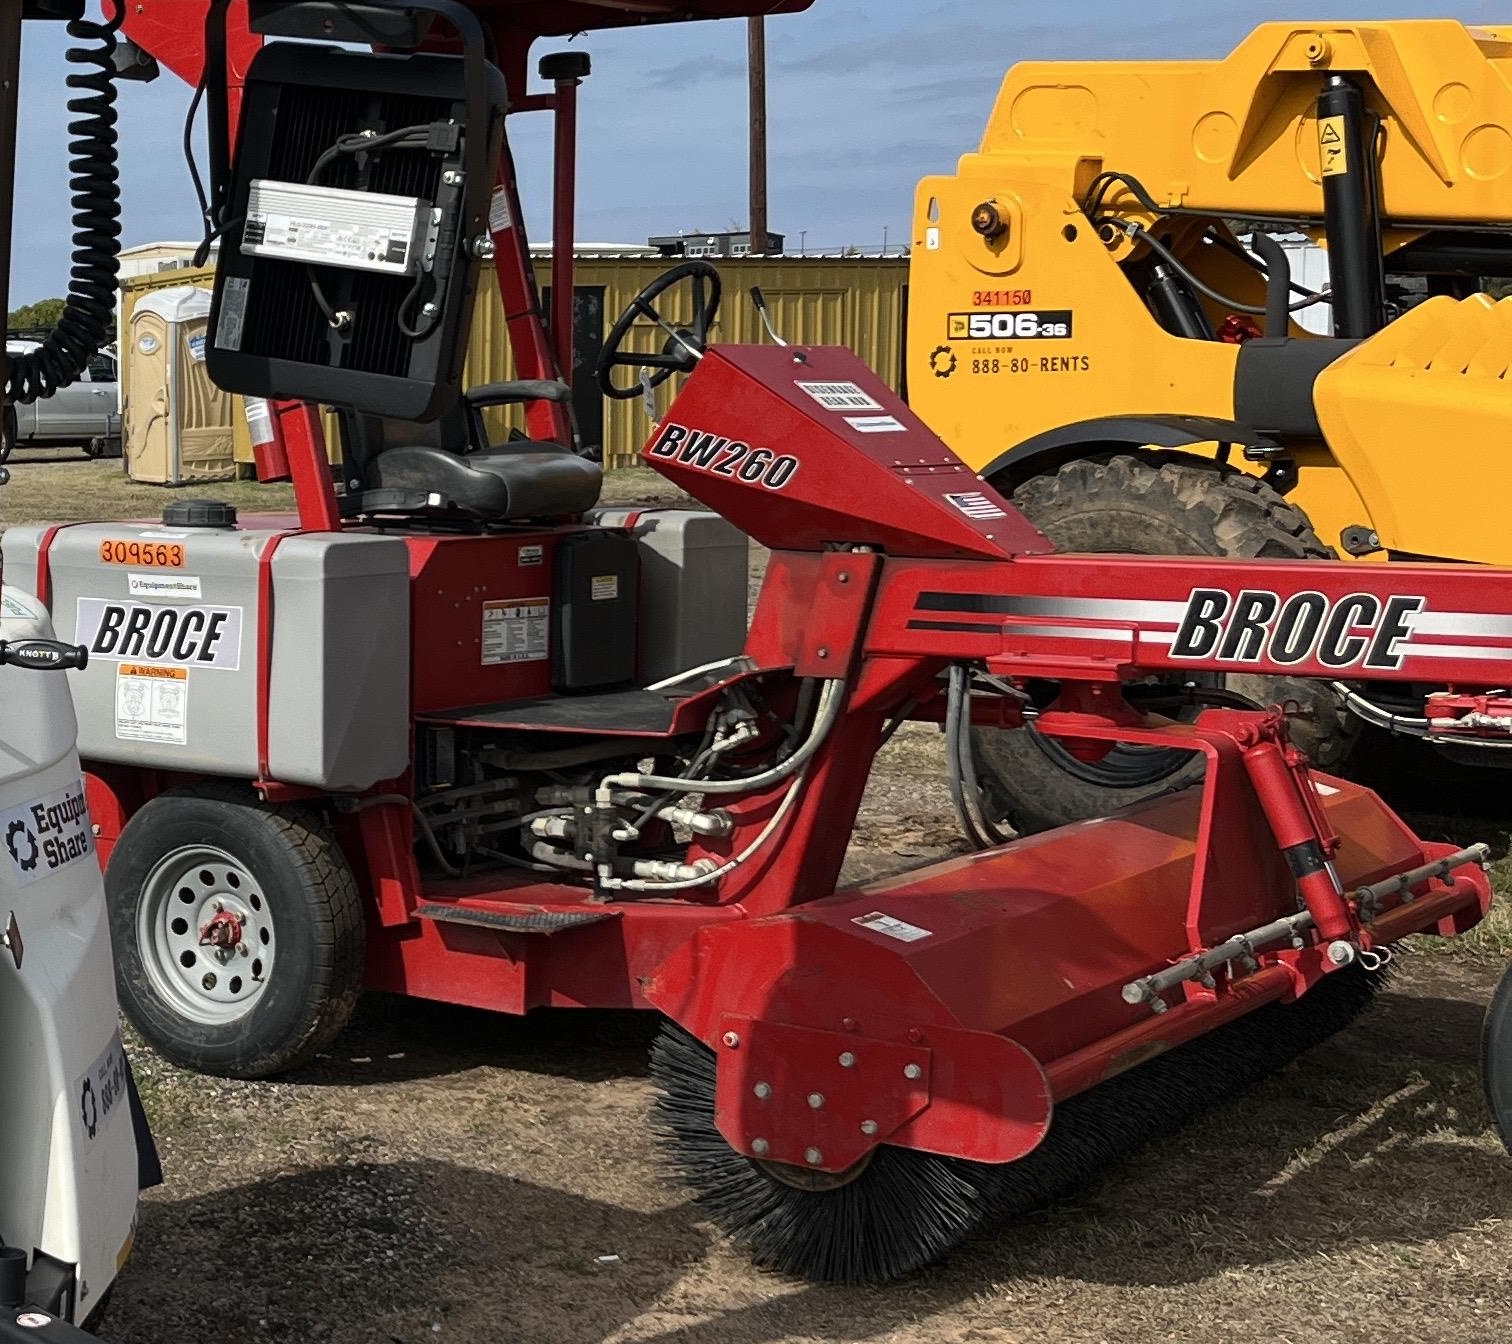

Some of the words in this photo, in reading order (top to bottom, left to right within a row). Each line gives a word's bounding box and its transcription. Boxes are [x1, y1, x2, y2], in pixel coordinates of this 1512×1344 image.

[973, 289, 1032, 306] 341150
[969, 312, 1068, 338] 506-36
[972, 355, 1090, 375] 888-80-RENTS
[649, 423, 800, 490] BW260
[101, 540, 183, 567] 309563
[90, 605, 229, 662] BROCE
[1168, 587, 1426, 670] BROCE
[138, 666, 176, 678] WARNING
[42, 831, 88, 869] Share
